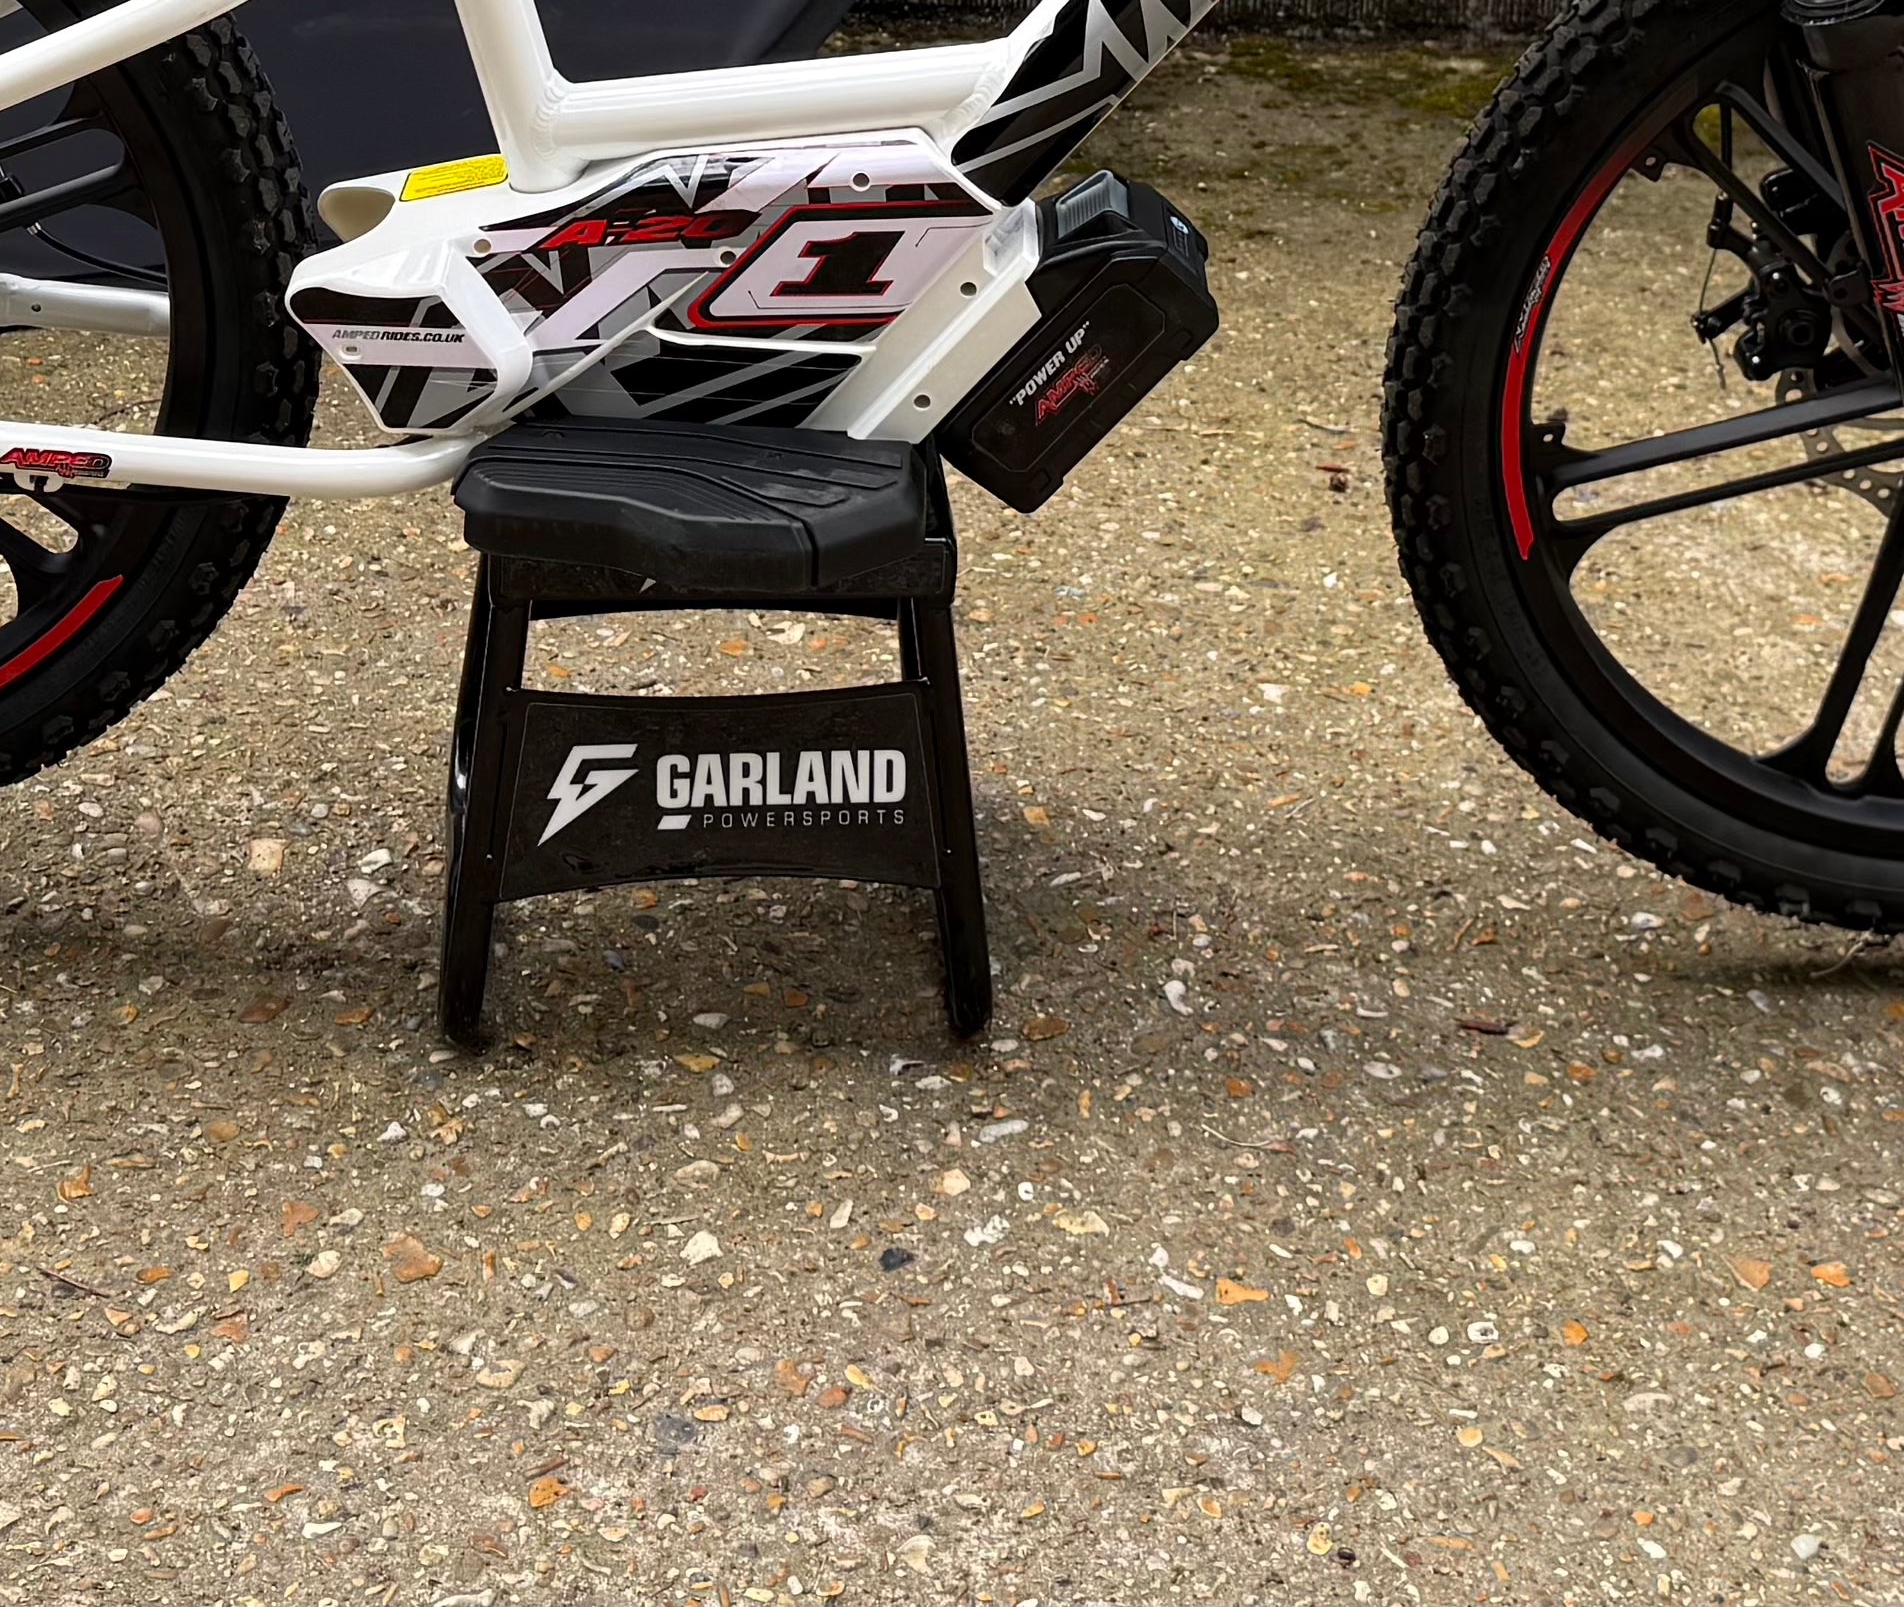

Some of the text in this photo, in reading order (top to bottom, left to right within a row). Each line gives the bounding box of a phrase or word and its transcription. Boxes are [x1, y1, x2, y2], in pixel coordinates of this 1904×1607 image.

[769, 230, 906, 297] 1
[656, 749, 907, 809] GARLAND
[703, 809, 905, 829] POWERSPORTS
